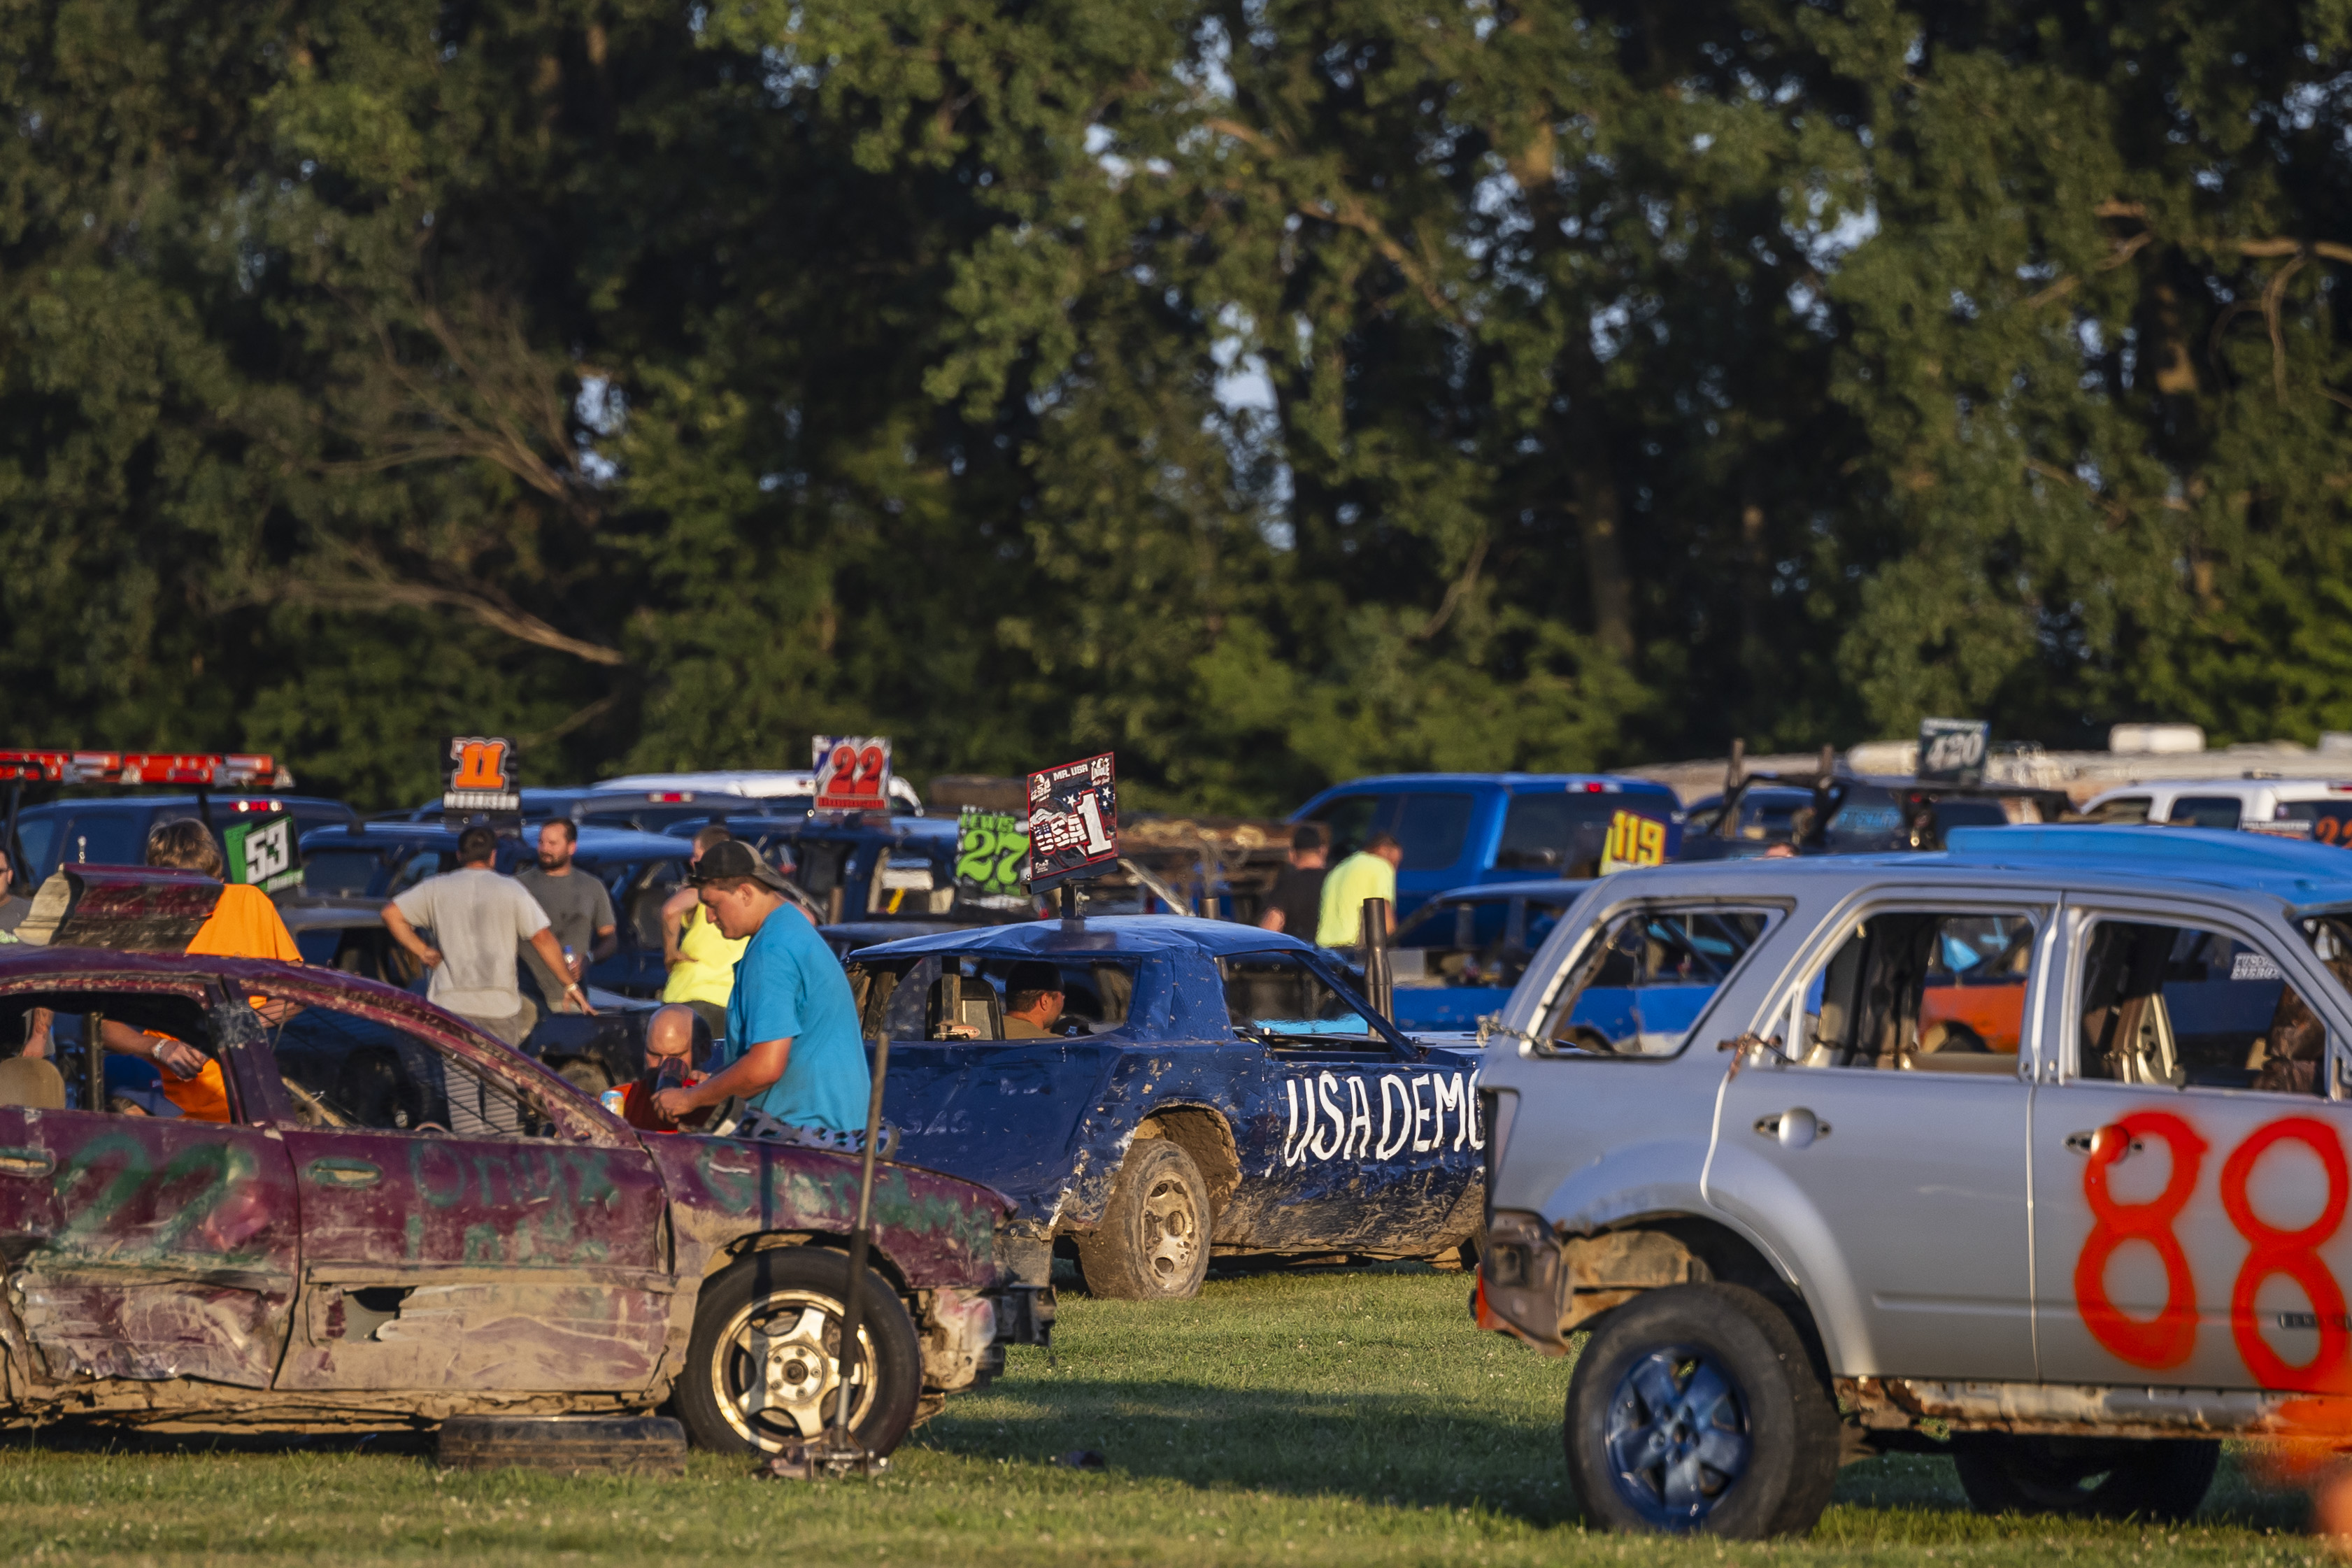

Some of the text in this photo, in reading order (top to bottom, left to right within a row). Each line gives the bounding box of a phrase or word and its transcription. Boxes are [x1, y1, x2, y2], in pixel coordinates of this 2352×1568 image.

[454, 739, 506, 790] 11
[827, 746, 883, 795] 22
[1070, 764, 1089, 777] USA
[1077, 792, 1113, 855] 1
[1611, 809, 1666, 867] 119
[245, 820, 288, 885] 53
[955, 829, 1030, 885] 27
[2073, 1110, 2349, 1393] 88
